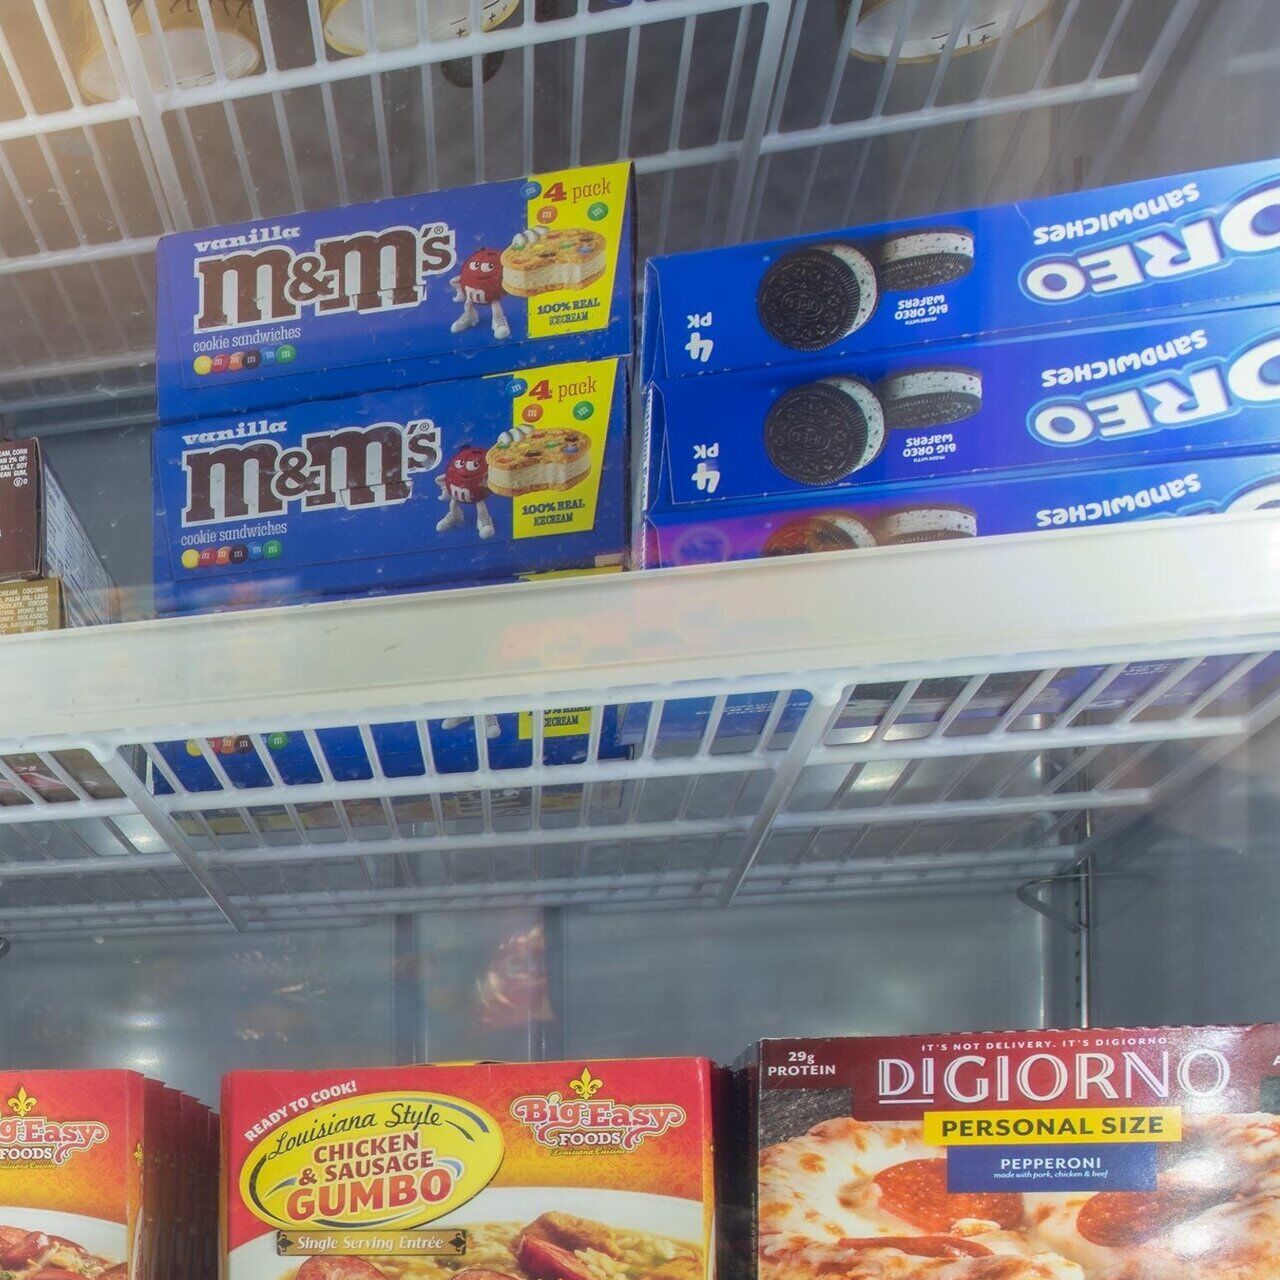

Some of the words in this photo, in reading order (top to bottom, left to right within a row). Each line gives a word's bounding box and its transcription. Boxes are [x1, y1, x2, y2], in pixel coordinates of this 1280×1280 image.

[543, 182, 567, 202] 4
[572, 177, 611, 203] pack
[194, 225, 300, 252] vanilla
[1026, 186, 1280, 301] OREO
[537, 301, 571, 315] 100%
[573, 298, 600, 309] REAL
[895, 307, 926, 321] OREO
[927, 304, 948, 316] BIG
[687, 312, 712, 328] PK
[193, 335, 230, 353] cookie
[232, 325, 301, 347] sandwiches
[685, 332, 714, 362] 4
[529, 379, 552, 400] 4
[558, 376, 596, 402] pack
[1035, 336, 1280, 444] OREO
[182, 419, 286, 445] vanilla
[903, 445, 934, 457] OREO
[936, 443, 956, 455] BIG
[692, 463, 721, 494] 4
[522, 502, 556, 515] 100%
[557, 499, 585, 511] REAL
[181, 529, 216, 546] cookie
[219, 520, 287, 541] sandwiches
[788, 1051, 815, 1064] 29g
[922, 1044, 948, 1052] IT'S
[953, 1043, 981, 1051] NOT
[986, 1040, 1057, 1050] DELIVERY.
[1062, 1039, 1090, 1047] IT'S
[1096, 1037, 1172, 1047] DIGIORNO.
[768, 1064, 836, 1077] PROTEIN
[878, 1049, 1231, 1104] DIGIORNO
[244, 1108, 288, 1142] READY
[291, 1096, 309, 1112] TO
[311, 1080, 358, 1104] COOK!
[268, 1113, 378, 1160] Louisiana
[385, 1103, 442, 1131] Style
[941, 1117, 1094, 1137] PERSONAL
[1102, 1115, 1163, 1134] SIZE
[314, 1132, 419, 1164] CHICKEN
[559, 1133, 622, 1146] FOODS
[298, 1167, 318, 1187] &
[325, 1150, 434, 1183] SAUSAGE
[1001, 1157, 1101, 1170] PEPPERONI
[1015, 1170, 1032, 1178] with
[1033, 1170, 1053, 1180] pork,
[1054, 1169, 1083, 1178] chicken
[1092, 1168, 1109, 1179] beef
[287, 1168, 452, 1221] GUMBO
[297, 1236, 338, 1251] Single
[343, 1237, 394, 1251] Serving
[398, 1236, 444, 1249] Entrée
